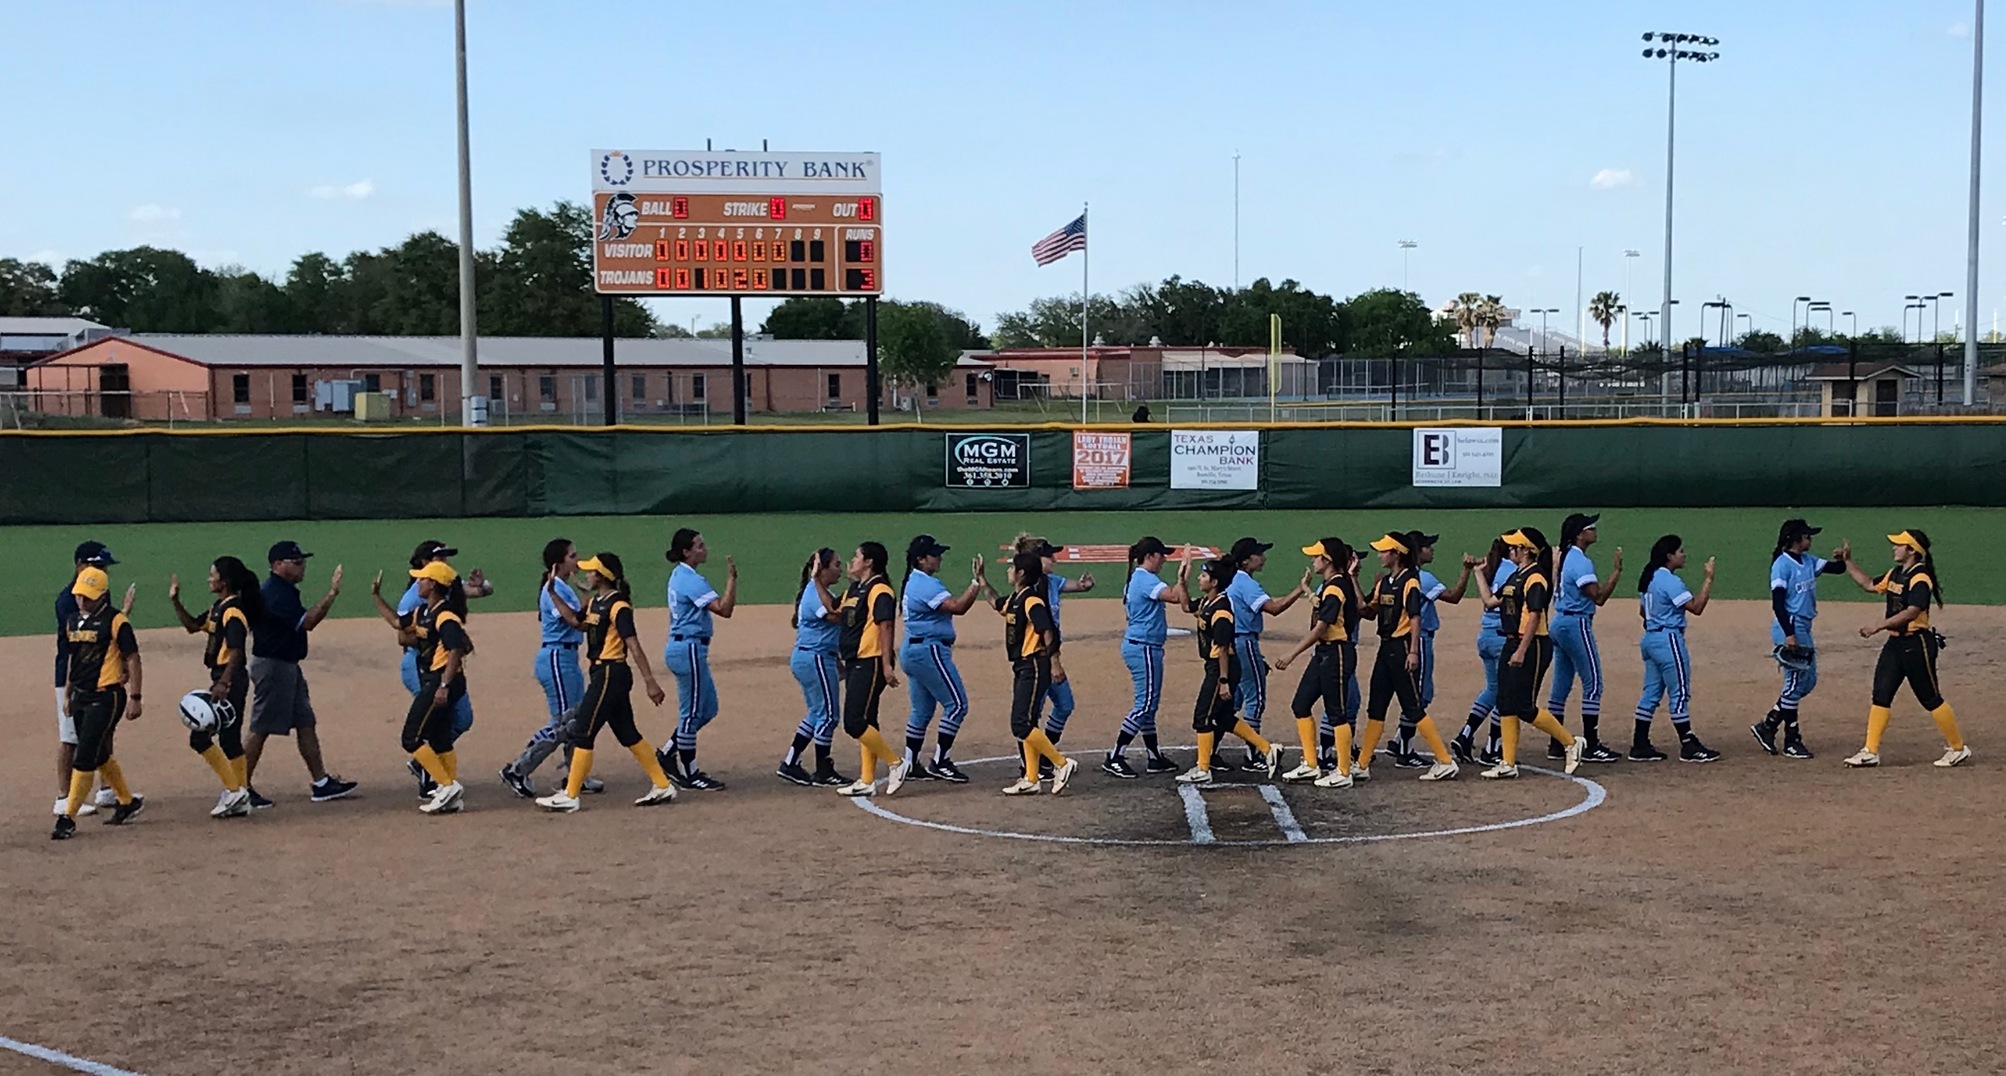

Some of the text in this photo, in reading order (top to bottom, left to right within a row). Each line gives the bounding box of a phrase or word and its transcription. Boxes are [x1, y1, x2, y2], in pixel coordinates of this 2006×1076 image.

[643, 159, 866, 178] PROSPERITY BANK
[641, 201, 672, 216] BALL
[723, 202, 768, 217] STRIKE
[833, 203, 858, 217] OUT
[659, 227, 822, 240] 1 2 3 4 5 6 7 8 9
[845, 229, 874, 240] RUNS
[604, 243, 654, 258] VISITOR
[655, 240, 670, 261] 0
[675, 240, 689, 261] 0
[694, 240, 709, 261] 0
[713, 240, 728, 262] 0
[733, 240, 747, 262] 0
[753, 240, 766, 262] 0
[772, 241, 786, 262] 0
[600, 270, 654, 285] TROJANS
[1173, 434, 1214, 444] TEXAS
[963, 441, 1016, 458] MGM
[1174, 444, 1256, 456] CHAMPION
[1077, 450, 1126, 464] 2017
[1219, 456, 1254, 465] BANK
